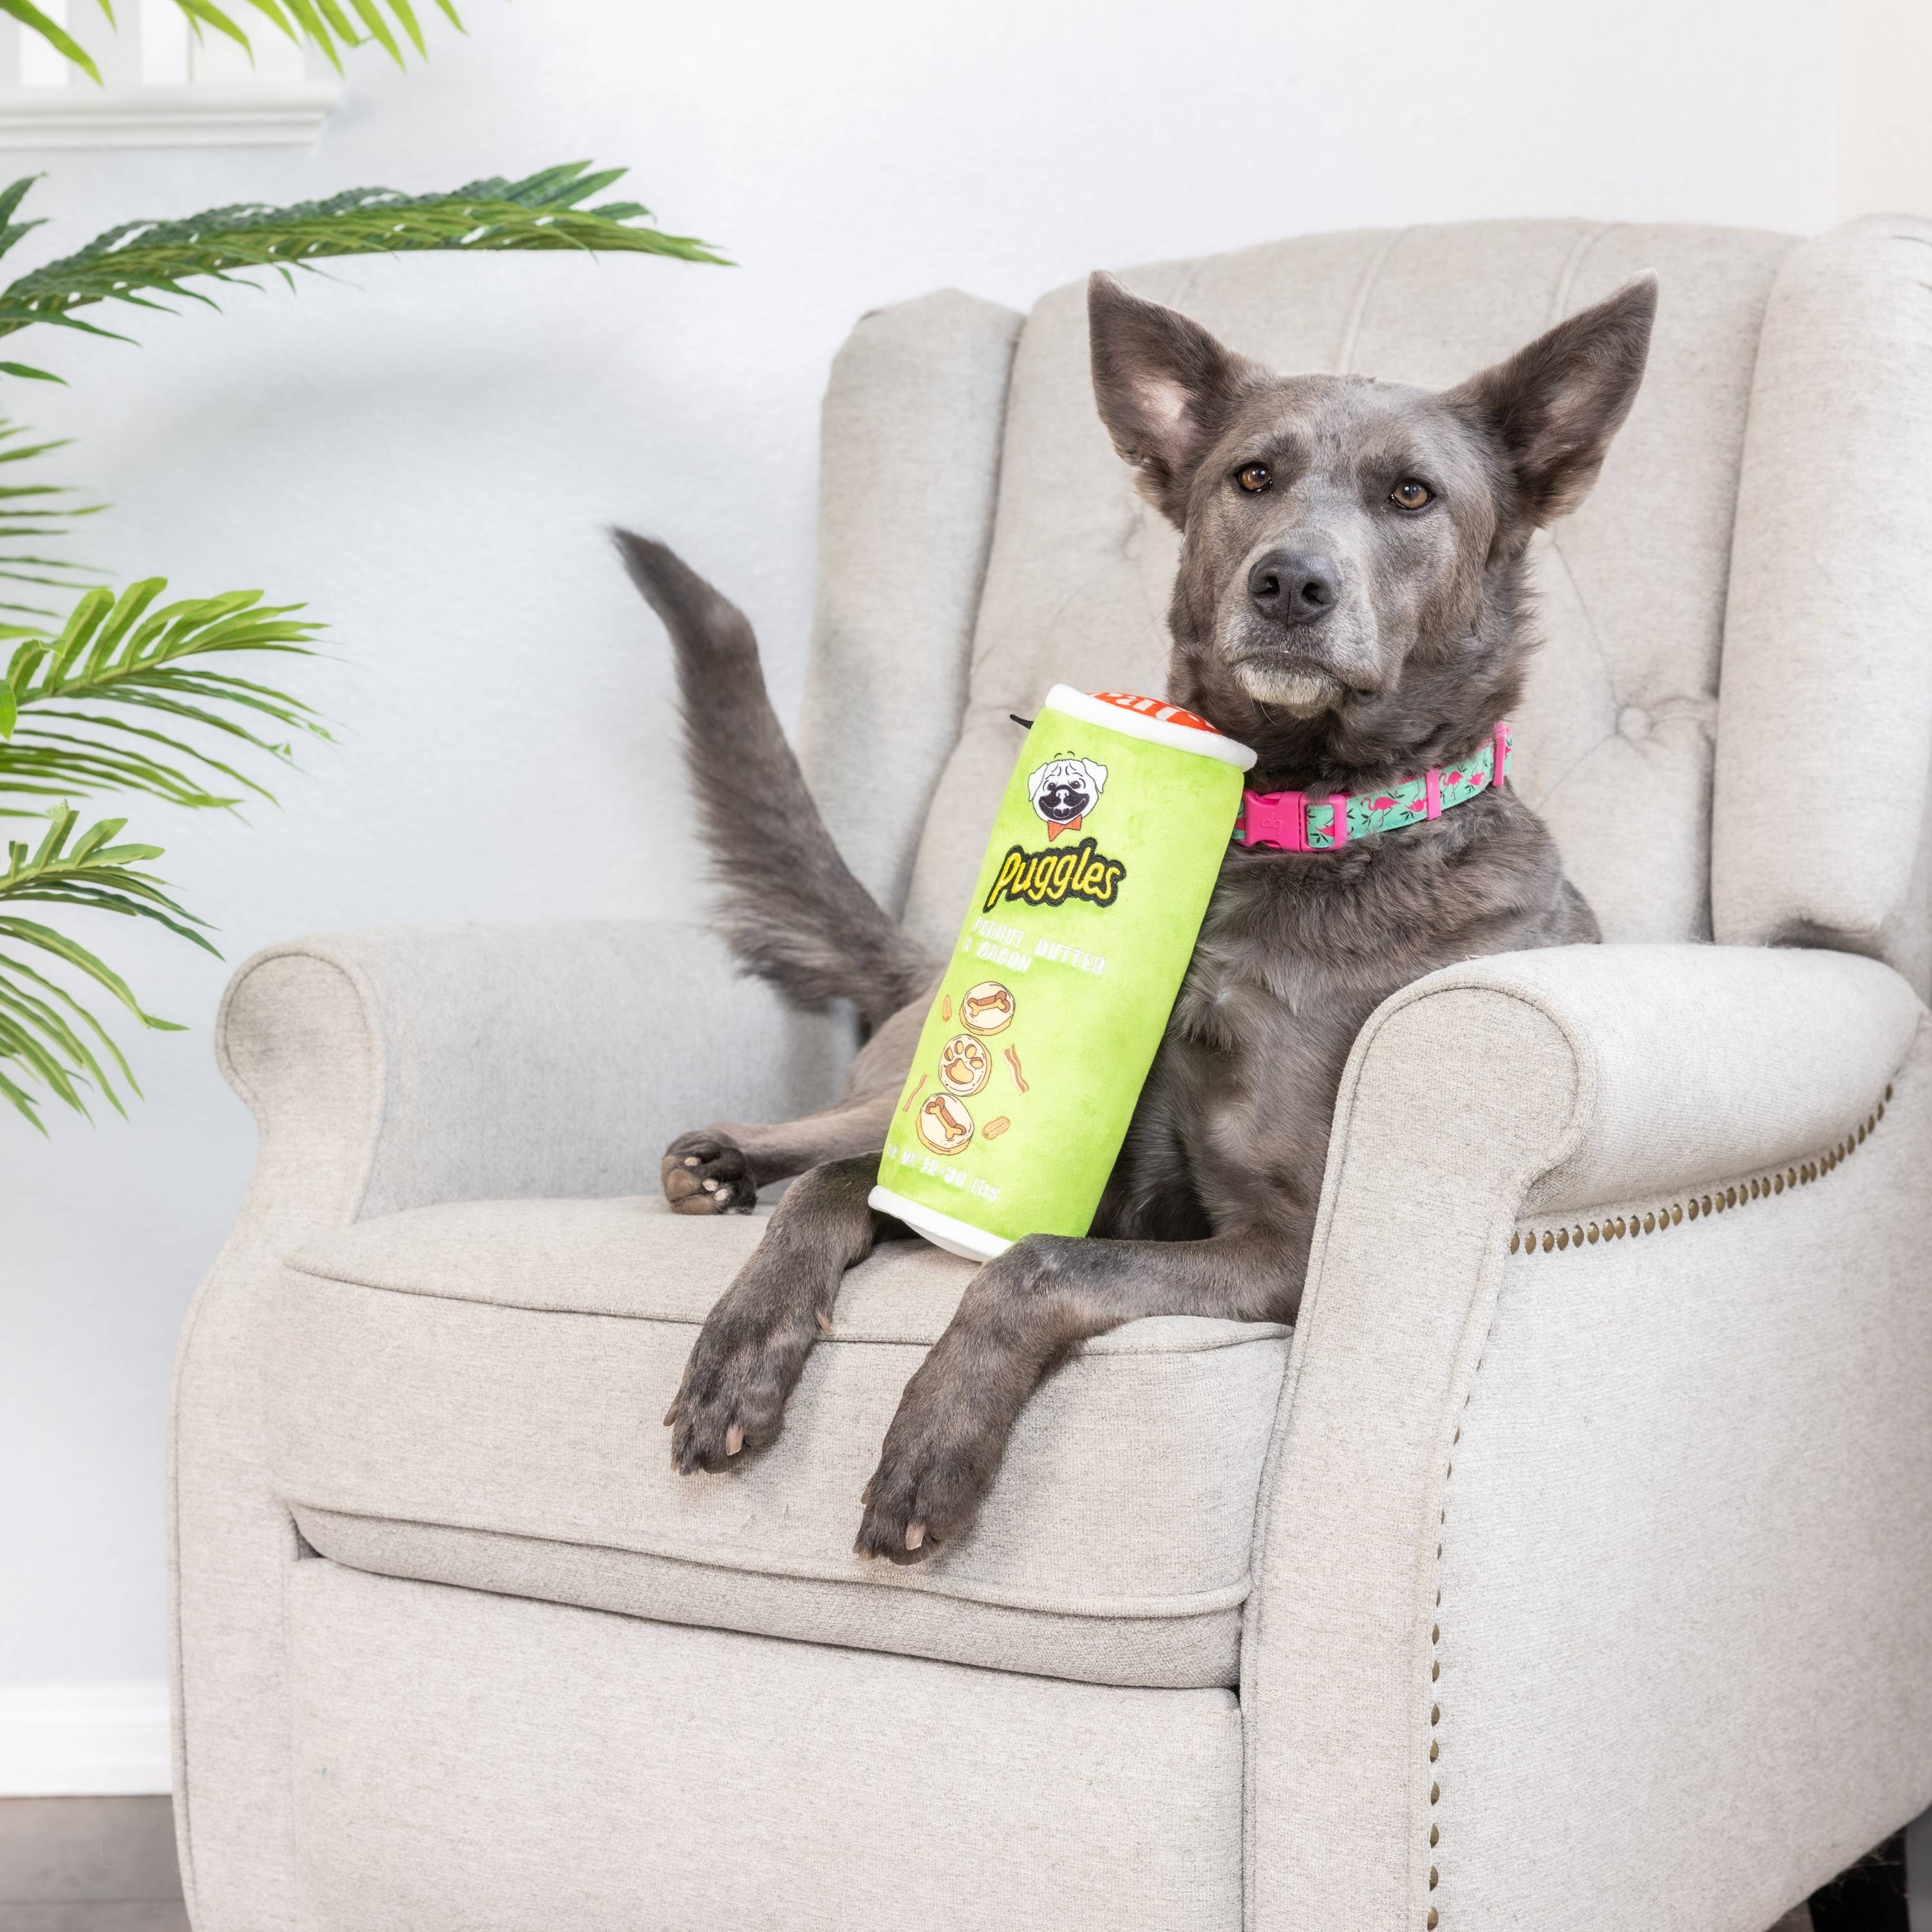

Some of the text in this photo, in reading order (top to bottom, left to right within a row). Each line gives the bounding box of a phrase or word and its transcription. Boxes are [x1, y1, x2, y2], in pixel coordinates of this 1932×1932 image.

[972, 916, 1106, 976] PEANUT BUTTER
[976, 941, 1032, 973] BACON
[970, 1177, 1000, 1202] lbs
